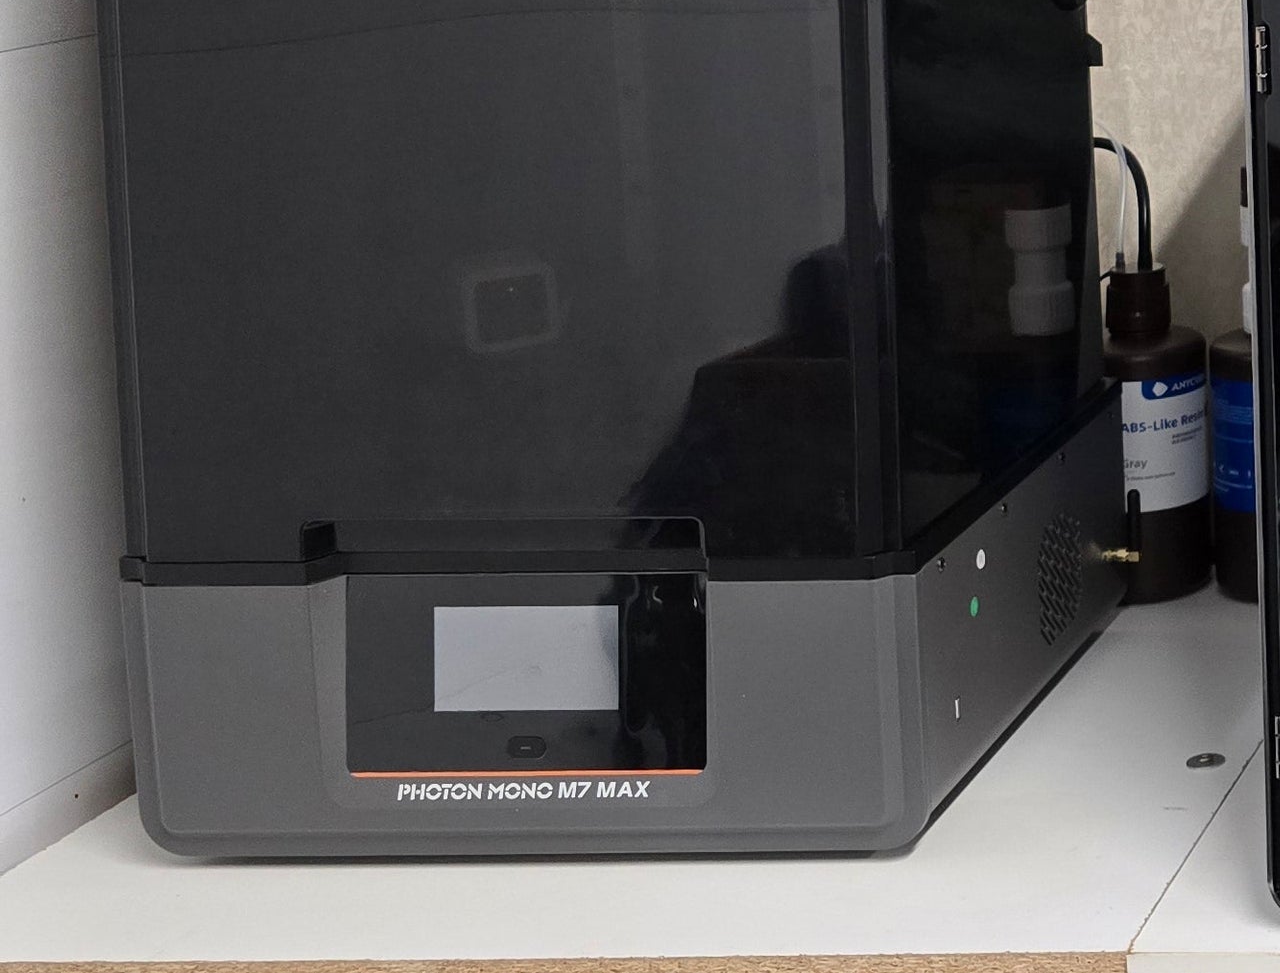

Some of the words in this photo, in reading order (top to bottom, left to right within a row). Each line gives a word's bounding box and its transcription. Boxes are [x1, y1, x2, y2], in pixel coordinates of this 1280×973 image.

[396, 781, 483, 802] PHOTON
[487, 782, 554, 801] MONO
[557, 780, 590, 800] M7
[596, 779, 652, 799] MAX
